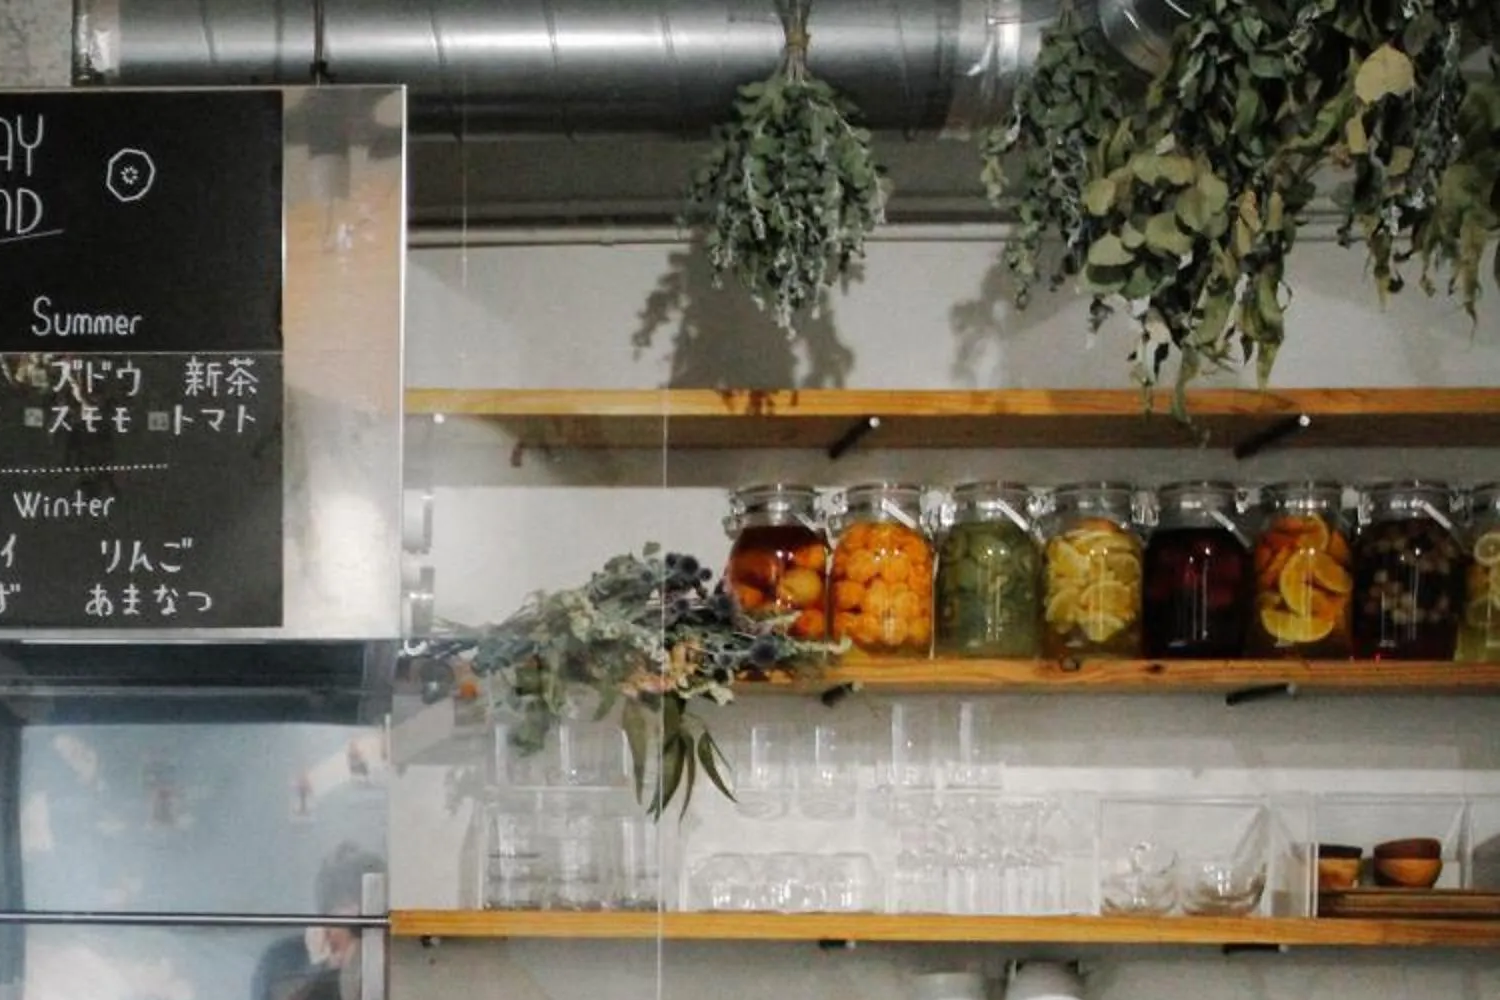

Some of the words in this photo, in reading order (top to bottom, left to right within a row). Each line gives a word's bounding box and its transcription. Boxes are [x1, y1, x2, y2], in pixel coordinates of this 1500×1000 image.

[31, 296, 143, 337] Summer
[183, 356, 259, 397] 新茶
[173, 404, 257, 436] トマト
[12, 489, 115, 518] Winter
[100, 536, 194, 574] りんご
[84, 582, 213, 618] あまなつ
